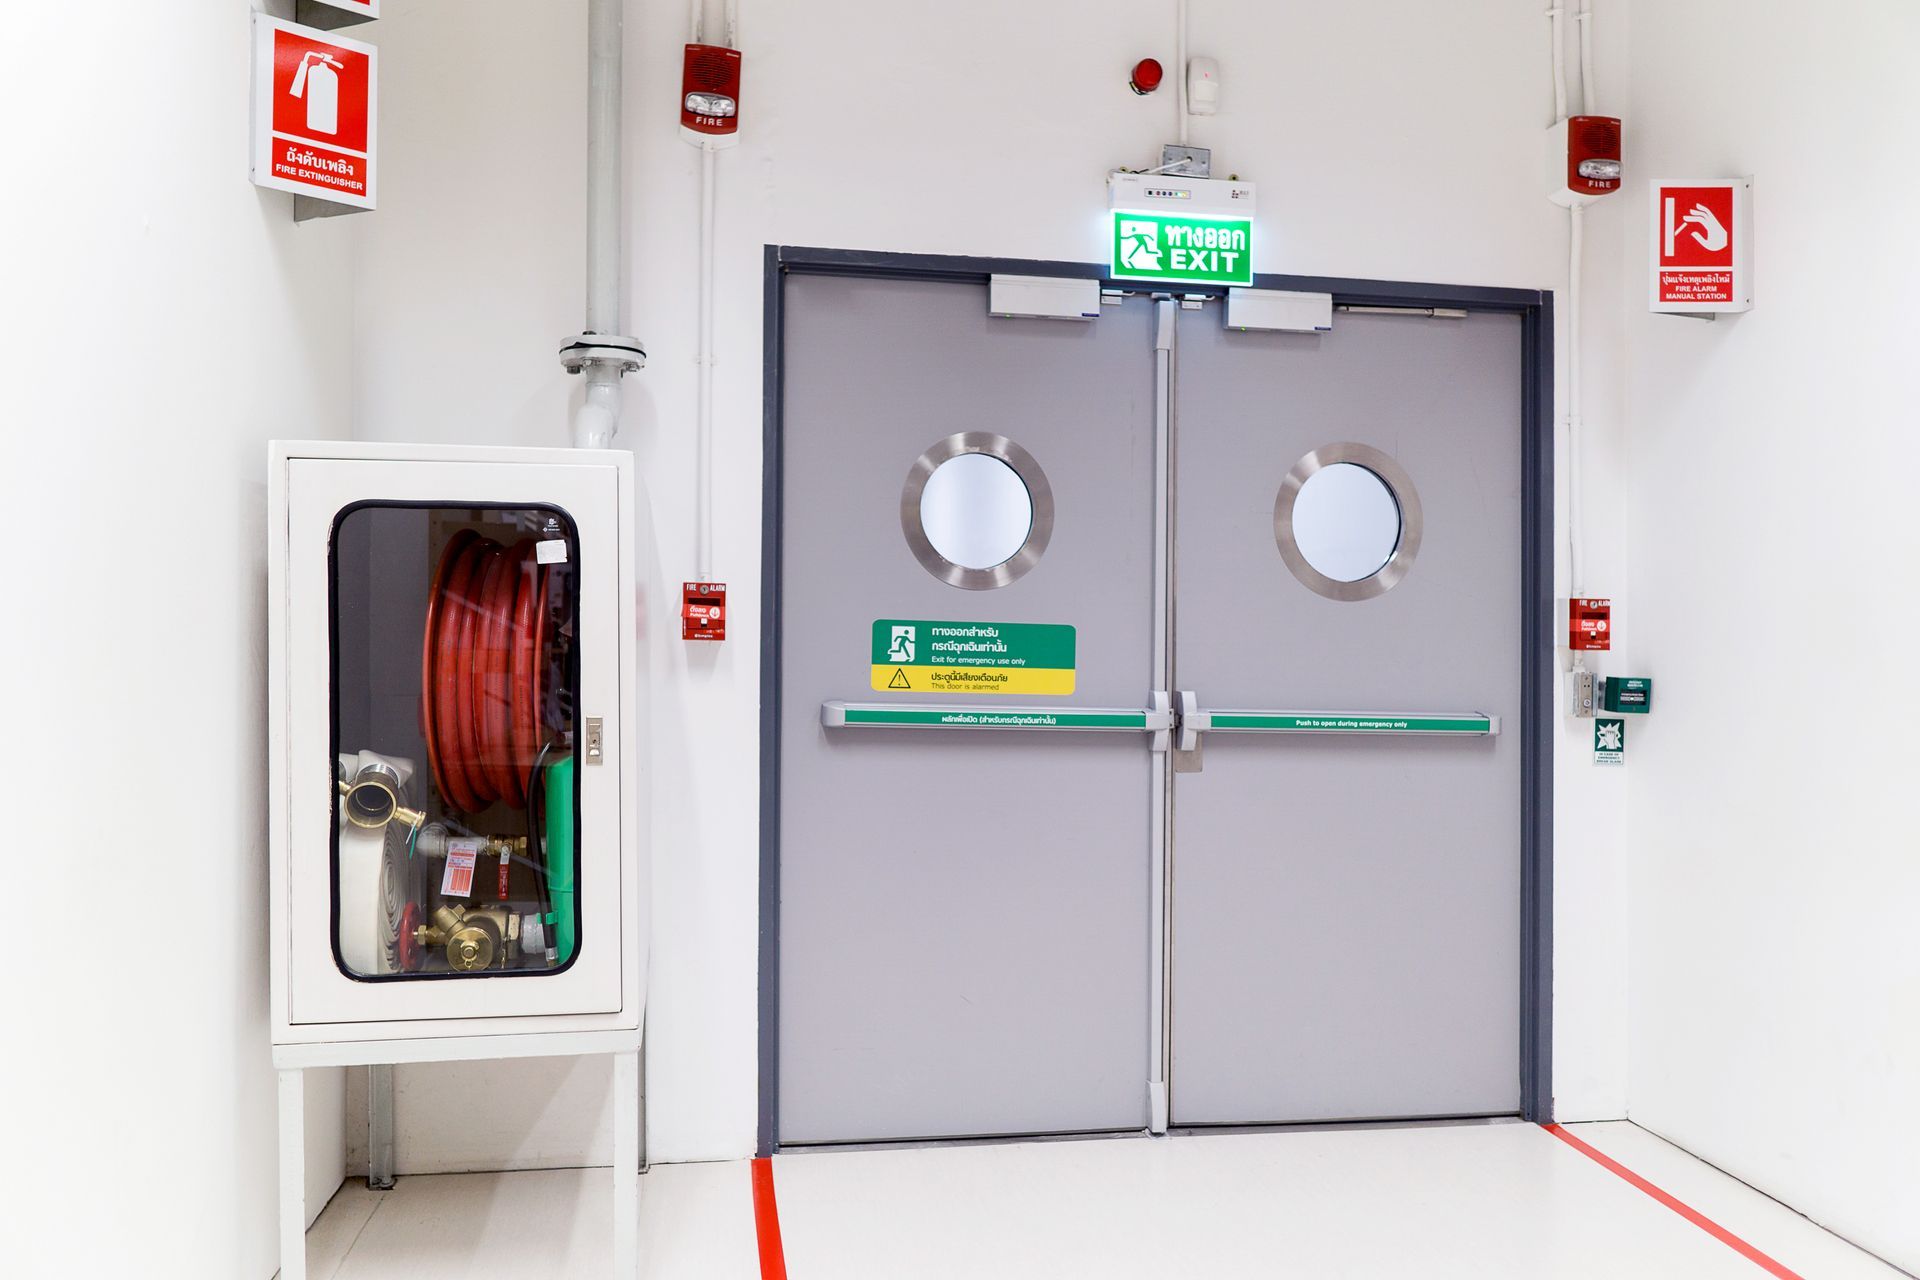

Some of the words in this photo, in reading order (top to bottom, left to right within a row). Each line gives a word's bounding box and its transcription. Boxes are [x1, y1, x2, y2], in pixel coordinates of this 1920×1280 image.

[695, 116, 723, 127] FIRE
[286, 147, 354, 176] ถังดับเพลิง
[275, 163, 297, 176] FIRE
[298, 168, 363, 190] EXTINGUISHER
[1588, 180, 1612, 189] FIRE
[1164, 225, 1246, 251] ทางออก
[1170, 248, 1240, 273] EXIT
[710, 584, 726, 592] ALARM
[932, 626, 999, 638] ทางออกสำหรับ
[931, 639, 1008, 654] กรณีฉุกเฉินเท่านั้น
[958, 657, 996, 666] emergency
[1011, 658, 1026, 667] only
[931, 670, 1008, 684] ประตูนี้มีเสียงเตือนภัย
[946, 682, 962, 690] door
[1295, 719, 1312, 727] Push
[1312, 719, 1320, 727] to
[1320, 721, 1337, 729] open
[1337, 720, 1358, 729] during
[1359, 721, 1393, 729] emergency
[1393, 720, 1408, 729] only
